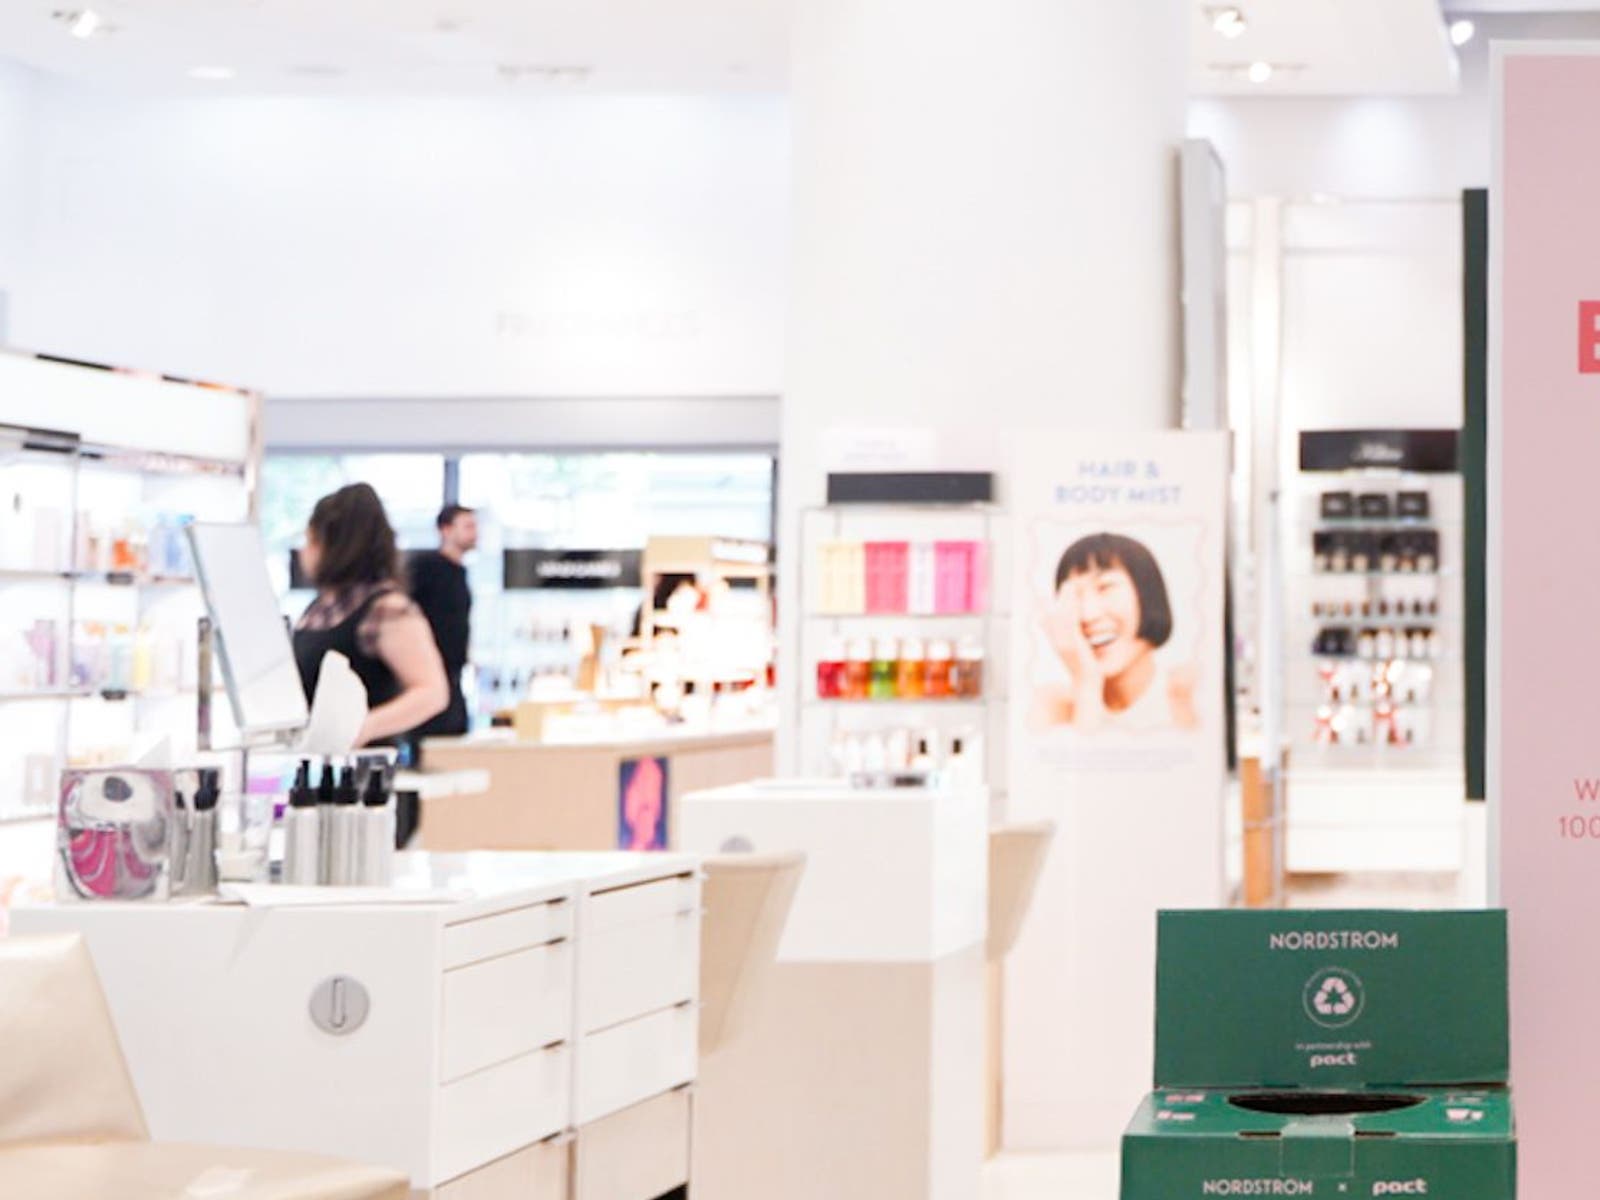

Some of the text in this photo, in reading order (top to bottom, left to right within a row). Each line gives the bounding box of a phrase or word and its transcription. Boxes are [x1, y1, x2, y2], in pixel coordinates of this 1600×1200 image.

[1270, 931, 1398, 949] NORDSTROM
[1310, 1052, 1356, 1067] pact
[1203, 1178, 1313, 1195] NORDSTROM
[1373, 1179, 1426, 1196] pact
